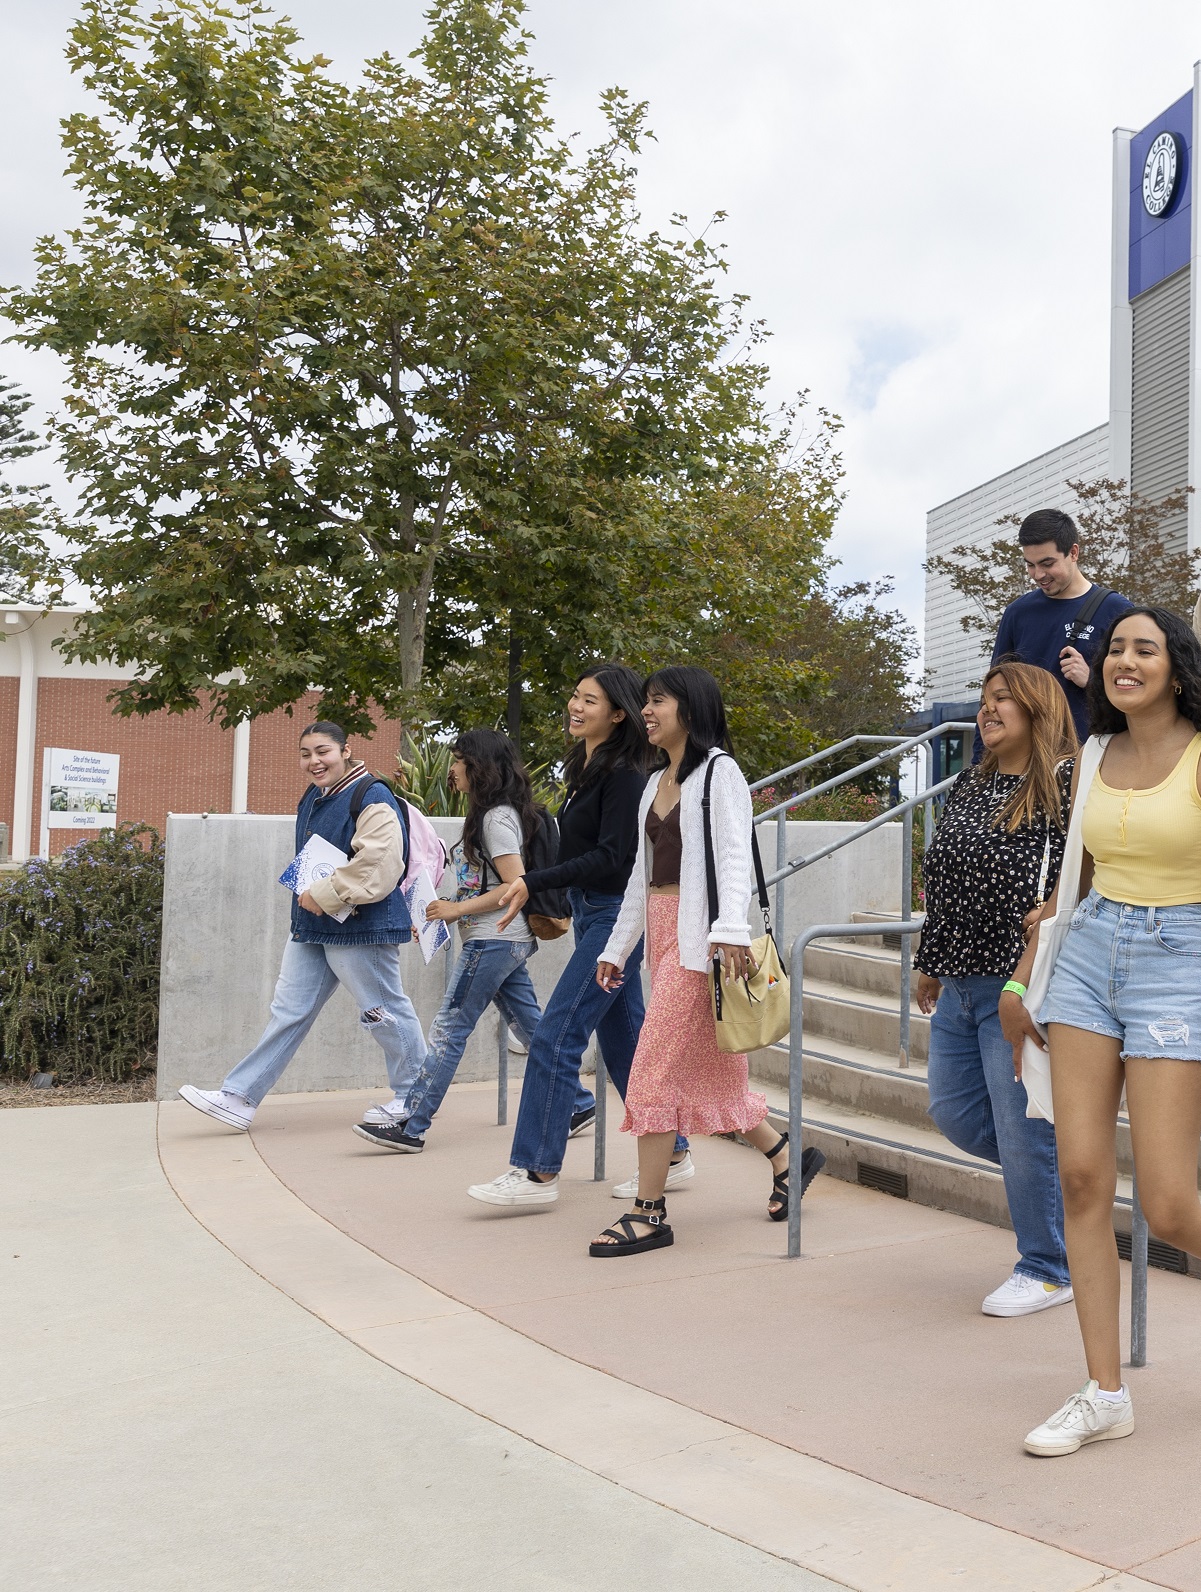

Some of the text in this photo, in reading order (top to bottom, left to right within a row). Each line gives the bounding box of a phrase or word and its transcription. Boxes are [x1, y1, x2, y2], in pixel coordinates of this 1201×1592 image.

[1145, 136, 1175, 179] EL CAMINO
[1146, 176, 1175, 212] COLLEGE
[70, 765, 85, 773] Complex
[91, 776, 107, 785] buildings
[73, 816, 86, 825] Coming
